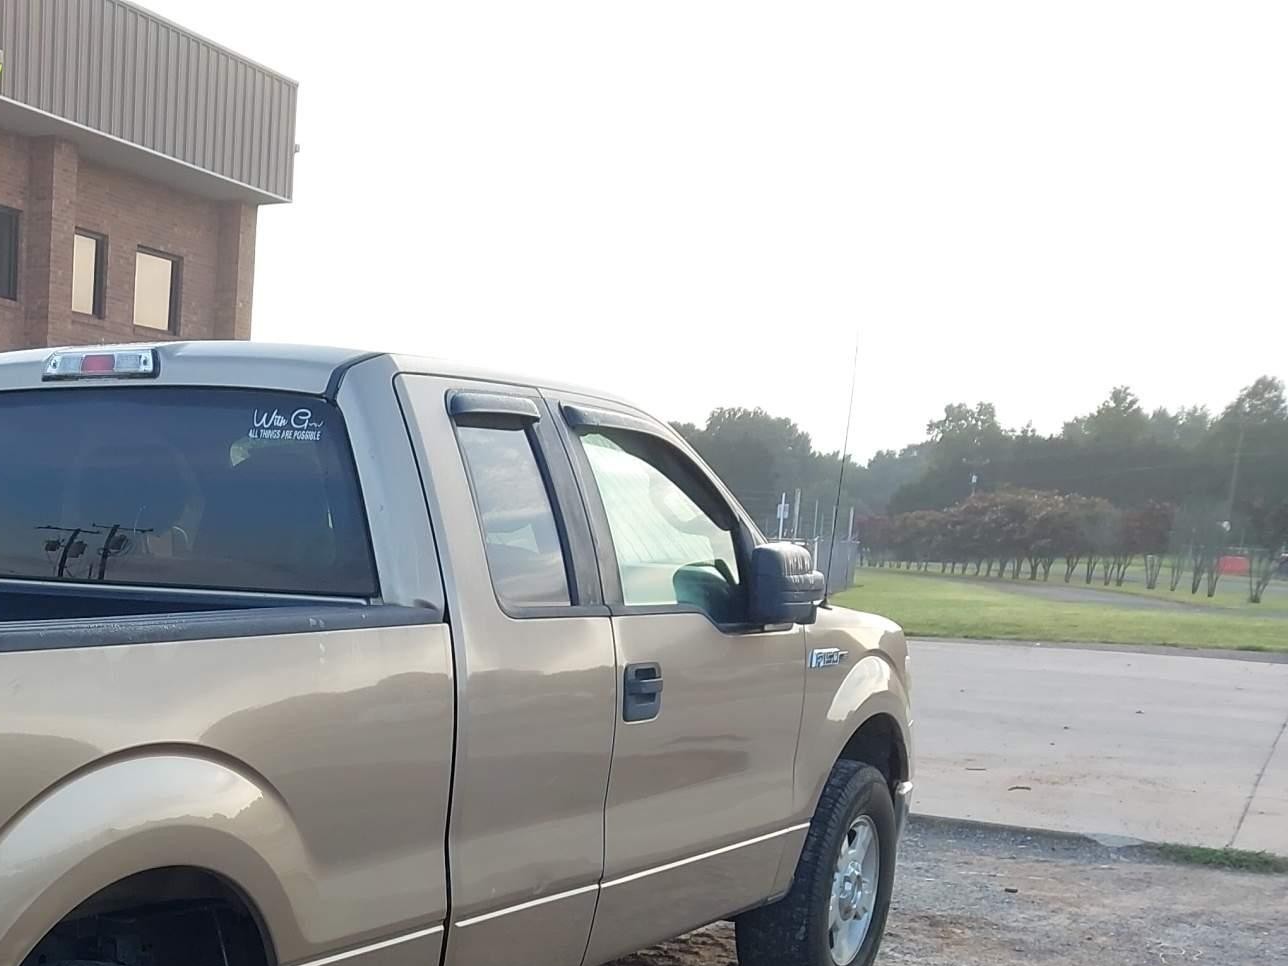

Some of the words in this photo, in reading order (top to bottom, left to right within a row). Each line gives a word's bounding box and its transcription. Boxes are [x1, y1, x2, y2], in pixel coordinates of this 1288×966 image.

[248, 428, 259, 438] ALL
[259, 429, 281, 440] THINGS
[280, 430, 293, 440] ARE
